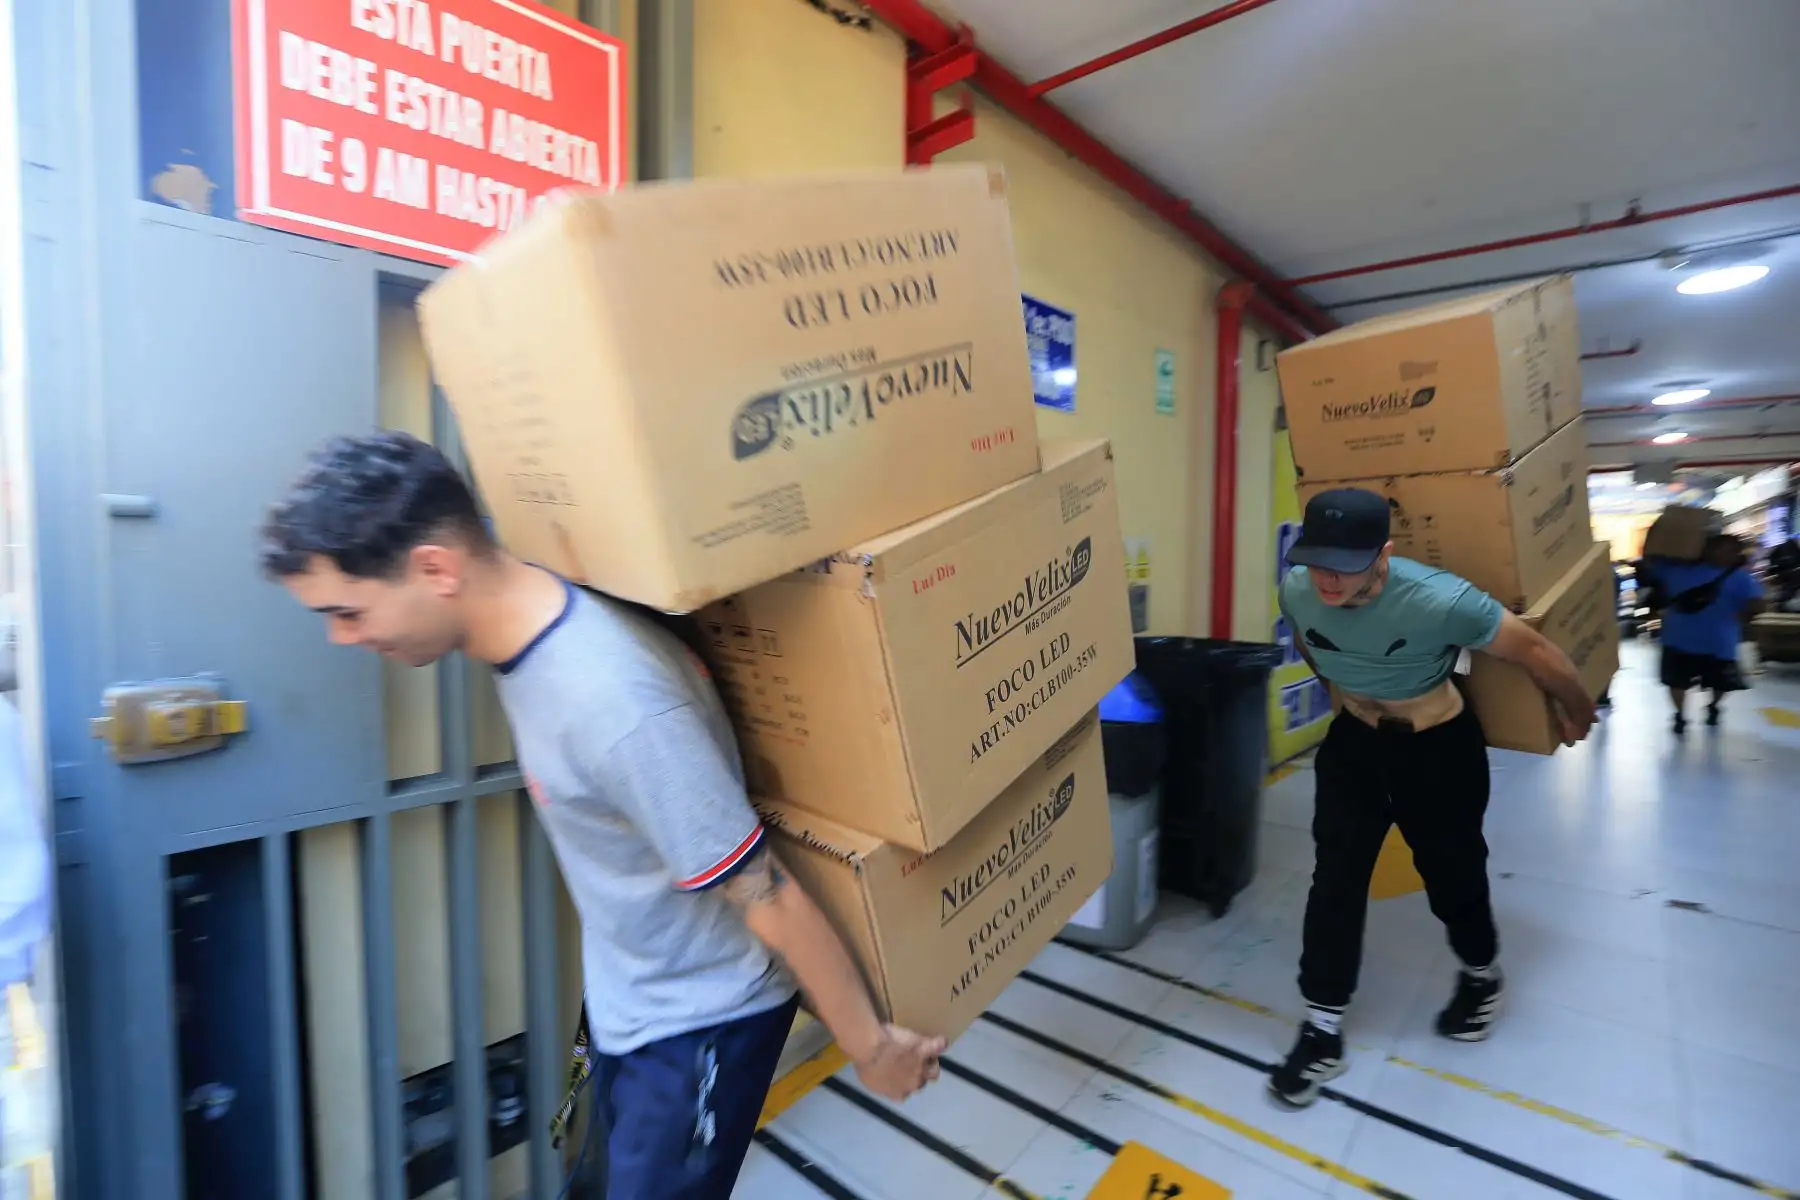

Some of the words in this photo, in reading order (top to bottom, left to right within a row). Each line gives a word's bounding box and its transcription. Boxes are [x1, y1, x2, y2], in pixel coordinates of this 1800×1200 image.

[350, 0, 435, 56] ESTA
[440, 12, 553, 100] PUERTA
[280, 31, 378, 115] DEBE
[384, 69, 484, 149] ESTAR
[489, 109, 602, 187] ABIERTA
[281, 119, 334, 185] DE
[340, 138, 366, 193] 9
[373, 147, 429, 209] AM
[783, 289, 850, 329] LED
[860, 272, 938, 315] FOCO
[1322, 392, 1409, 418] NuevoVelix
[1072, 549, 1089, 572] LED
[954, 557, 1071, 660] NuevoVelix
[970, 642, 1098, 764] ART.NO:CLB100-35W
[984, 659, 1035, 715] FOCO
[1040, 631, 1071, 670] LED
[1055, 785, 1073, 808] LED
[941, 801, 1054, 921] NuevoVelix
[968, 898, 1016, 955] FOCO
[1021, 863, 1051, 902] LED
